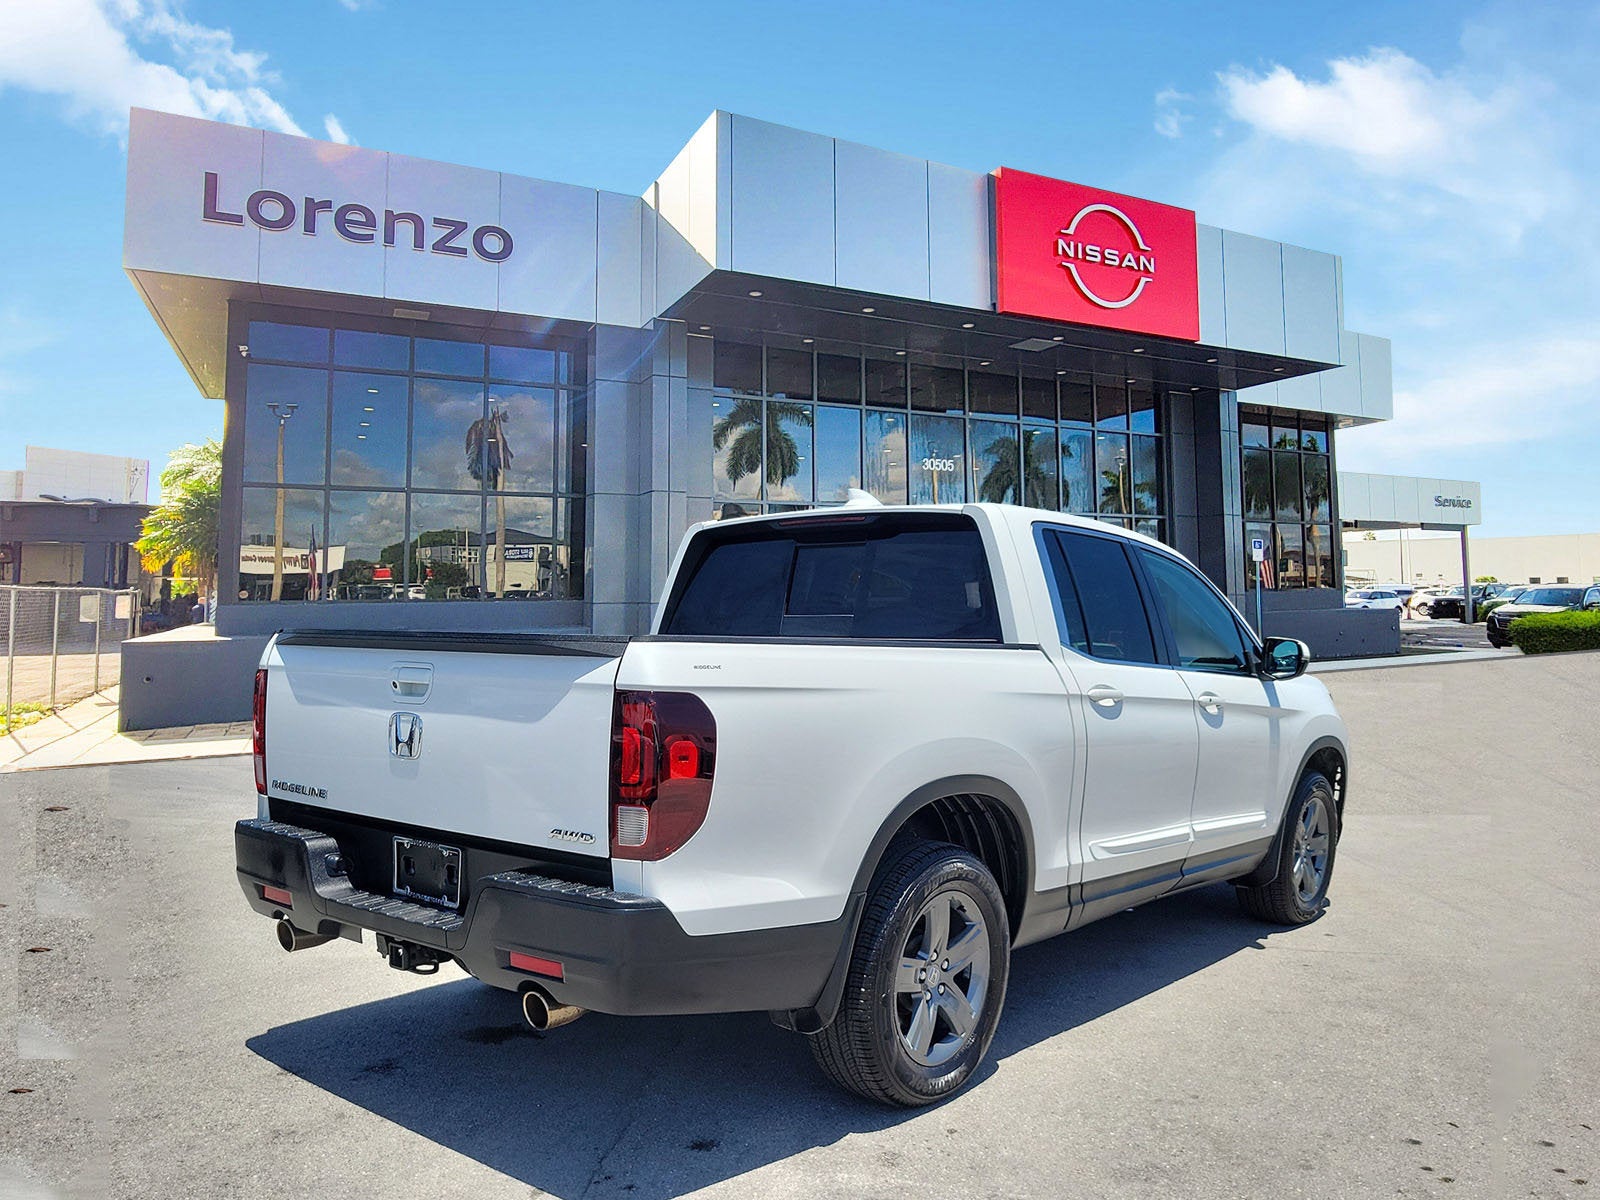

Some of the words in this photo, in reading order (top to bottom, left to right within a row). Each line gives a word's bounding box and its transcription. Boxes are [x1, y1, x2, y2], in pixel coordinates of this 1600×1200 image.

[203, 171, 514, 263] Lorenzo
[1057, 238, 1155, 273] NISSAN
[922, 457, 955, 472] 30505
[1434, 495, 1472, 509] Service
[271, 779, 328, 800] RIDGELINE
[549, 828, 596, 844] AWD
